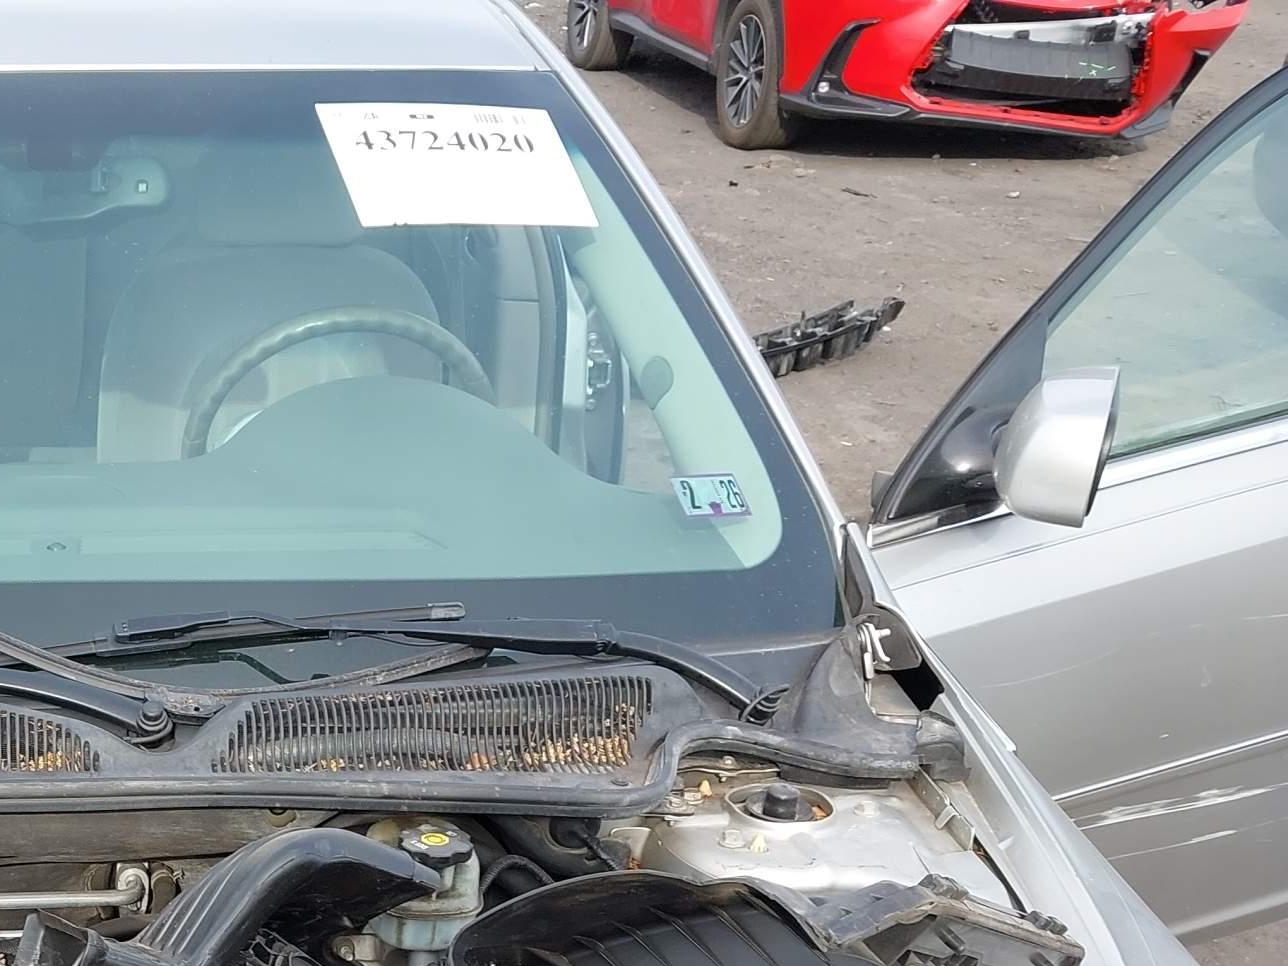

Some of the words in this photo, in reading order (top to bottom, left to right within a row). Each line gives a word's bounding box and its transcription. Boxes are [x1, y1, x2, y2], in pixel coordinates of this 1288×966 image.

[355, 130, 535, 153] 43724020
[679, 480, 703, 509] 2
[718, 479, 746, 509] 26
